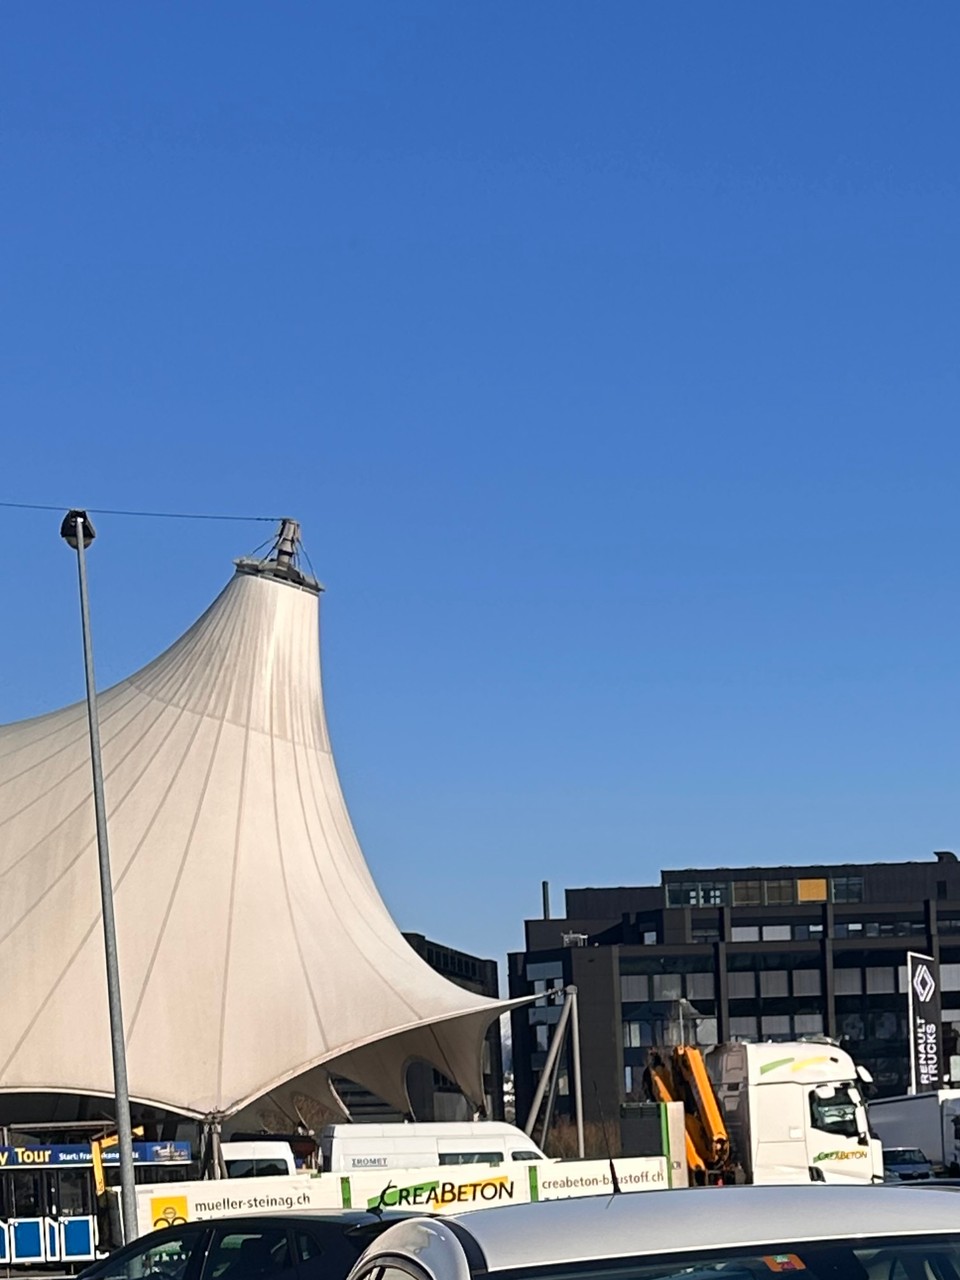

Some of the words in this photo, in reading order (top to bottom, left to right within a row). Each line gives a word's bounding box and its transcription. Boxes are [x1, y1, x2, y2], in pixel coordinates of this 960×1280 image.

[917, 1016, 930, 1084] RENAULT
[926, 1023, 939, 1082] TRUCKS
[14, 1148, 51, 1163] Tour
[195, 1193, 310, 1212] mueller-steinag.ch
